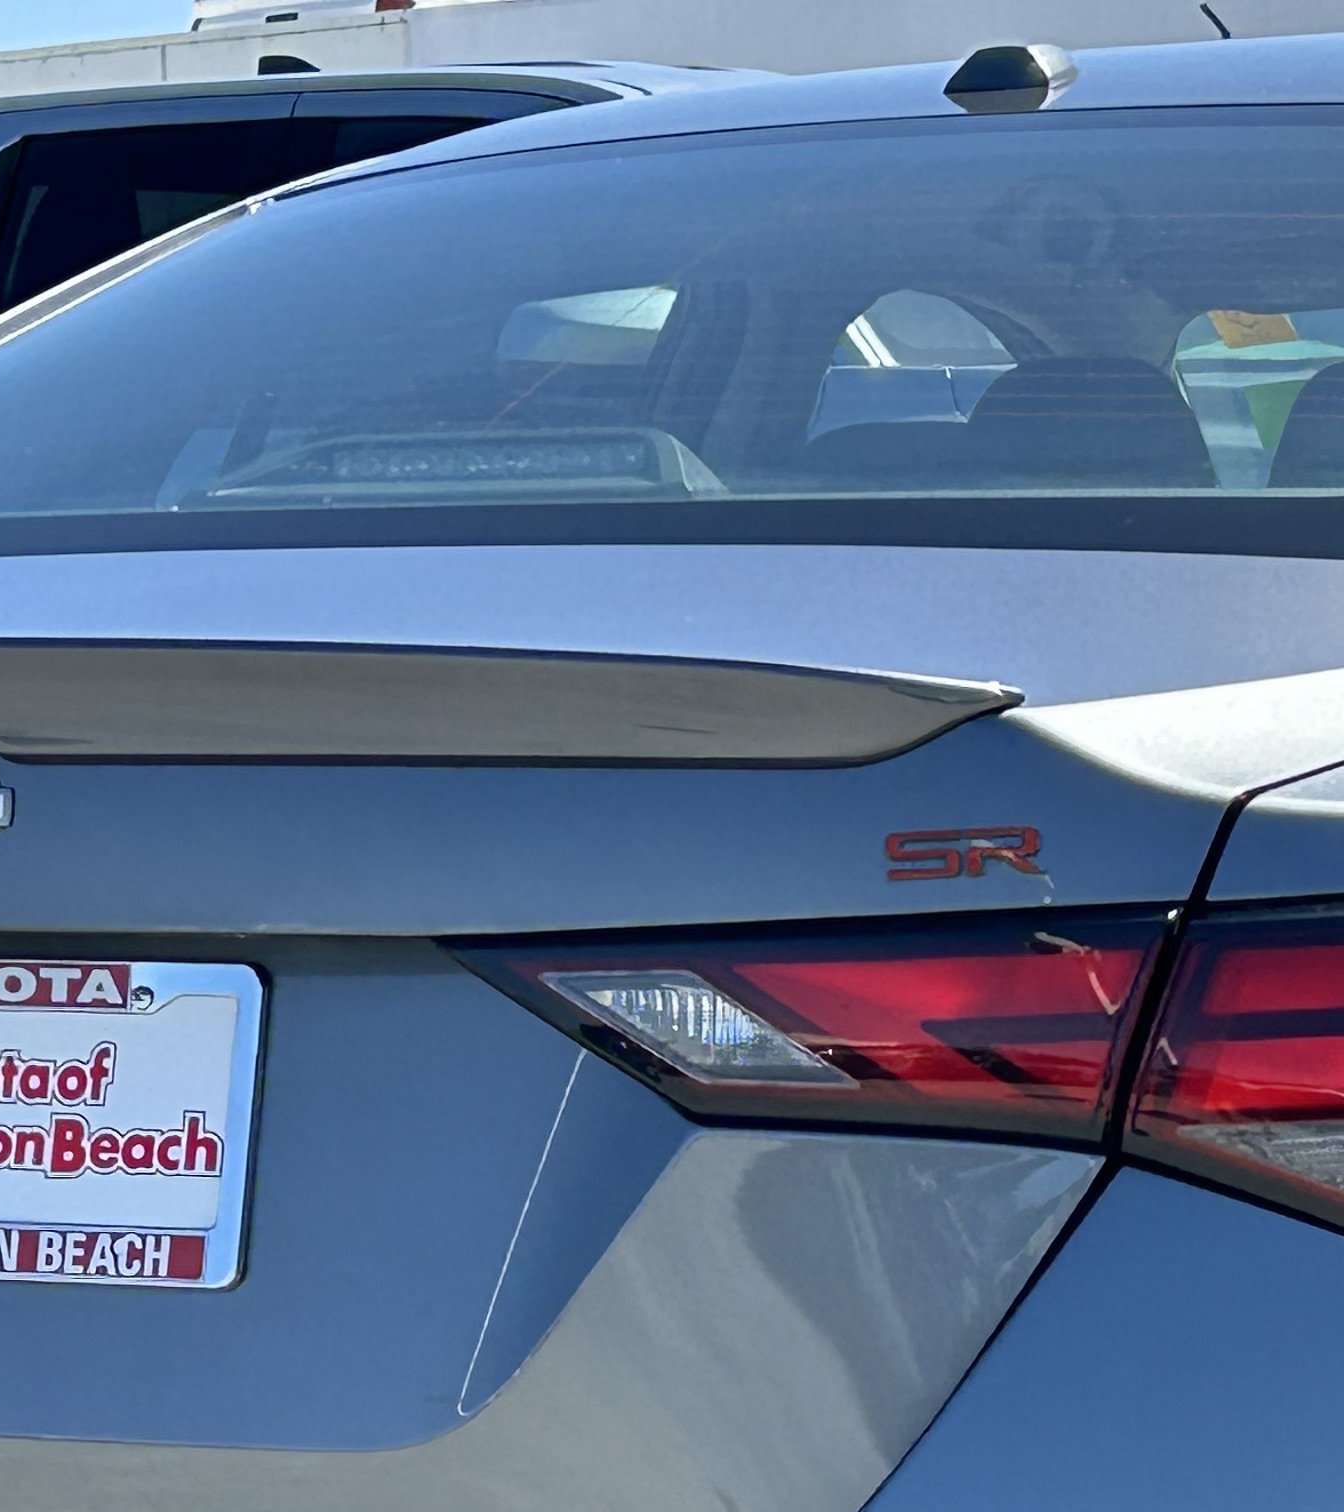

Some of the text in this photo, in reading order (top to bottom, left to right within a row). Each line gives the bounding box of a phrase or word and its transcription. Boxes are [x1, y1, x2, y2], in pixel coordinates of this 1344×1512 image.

[884, 825, 1045, 880] SR
[55, 1046, 112, 1101] of
[50, 1117, 219, 1174] Beach
[36, 1232, 171, 1279] BEACH
